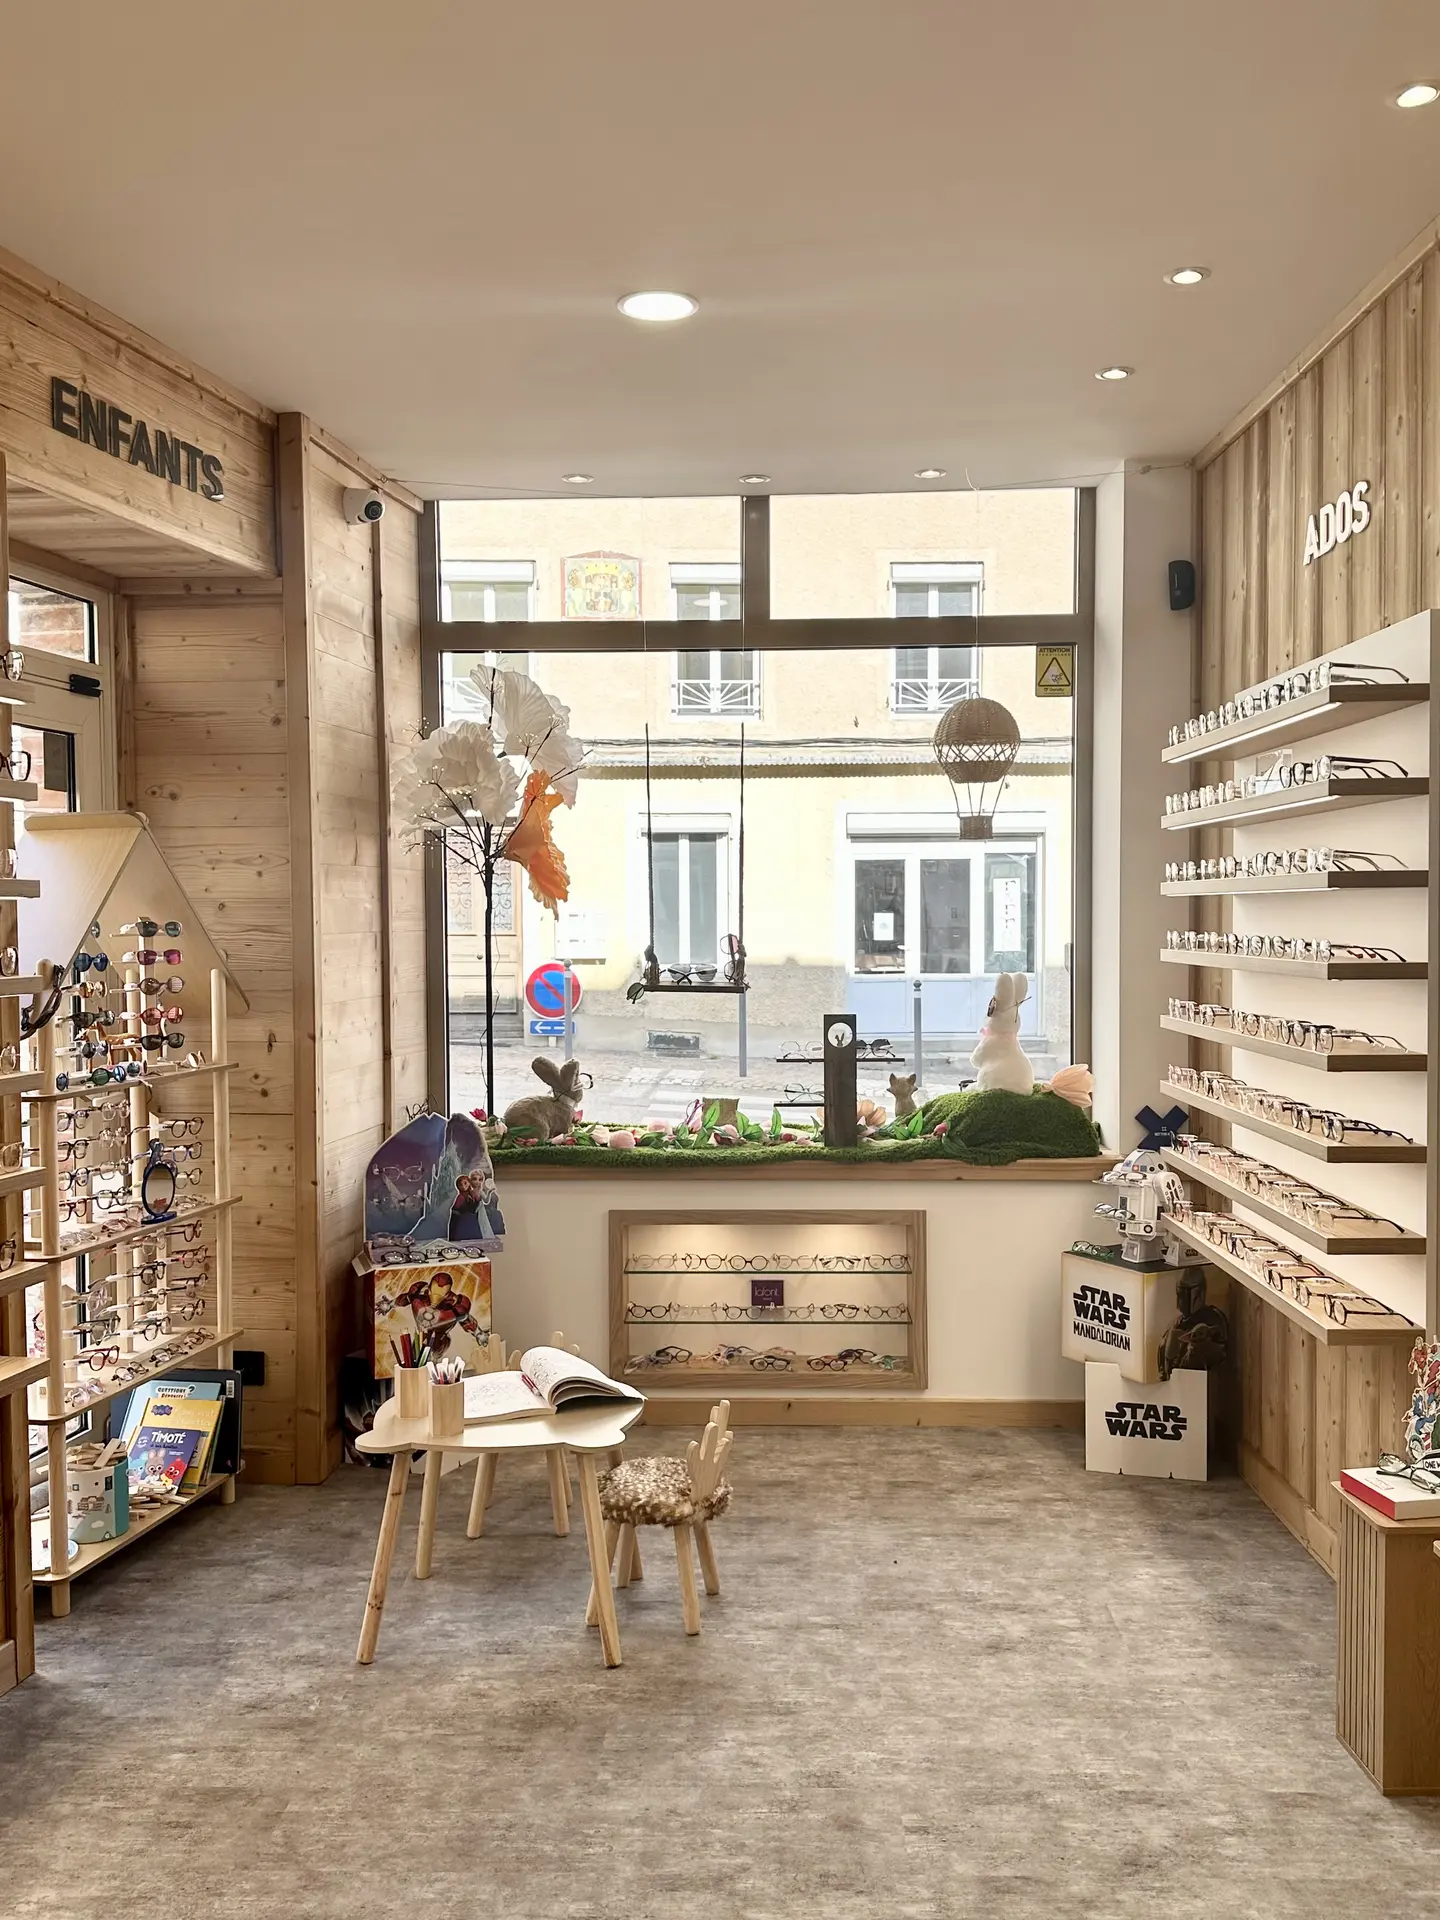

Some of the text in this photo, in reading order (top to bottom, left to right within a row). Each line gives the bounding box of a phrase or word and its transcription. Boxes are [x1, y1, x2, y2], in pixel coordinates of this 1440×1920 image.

[52, 376, 224, 502] ENFANTS
[1303, 480, 1370, 566] ADOS
[1073, 1285, 1130, 1314] STAR
[1073, 1300, 1130, 1330] WARS
[1073, 1321, 1131, 1351] MANDALORIAN
[1105, 1402, 1187, 1423] STAR
[1105, 1418, 1187, 1440] WARS
[1425, 1461, 1436, 1469] ONE
